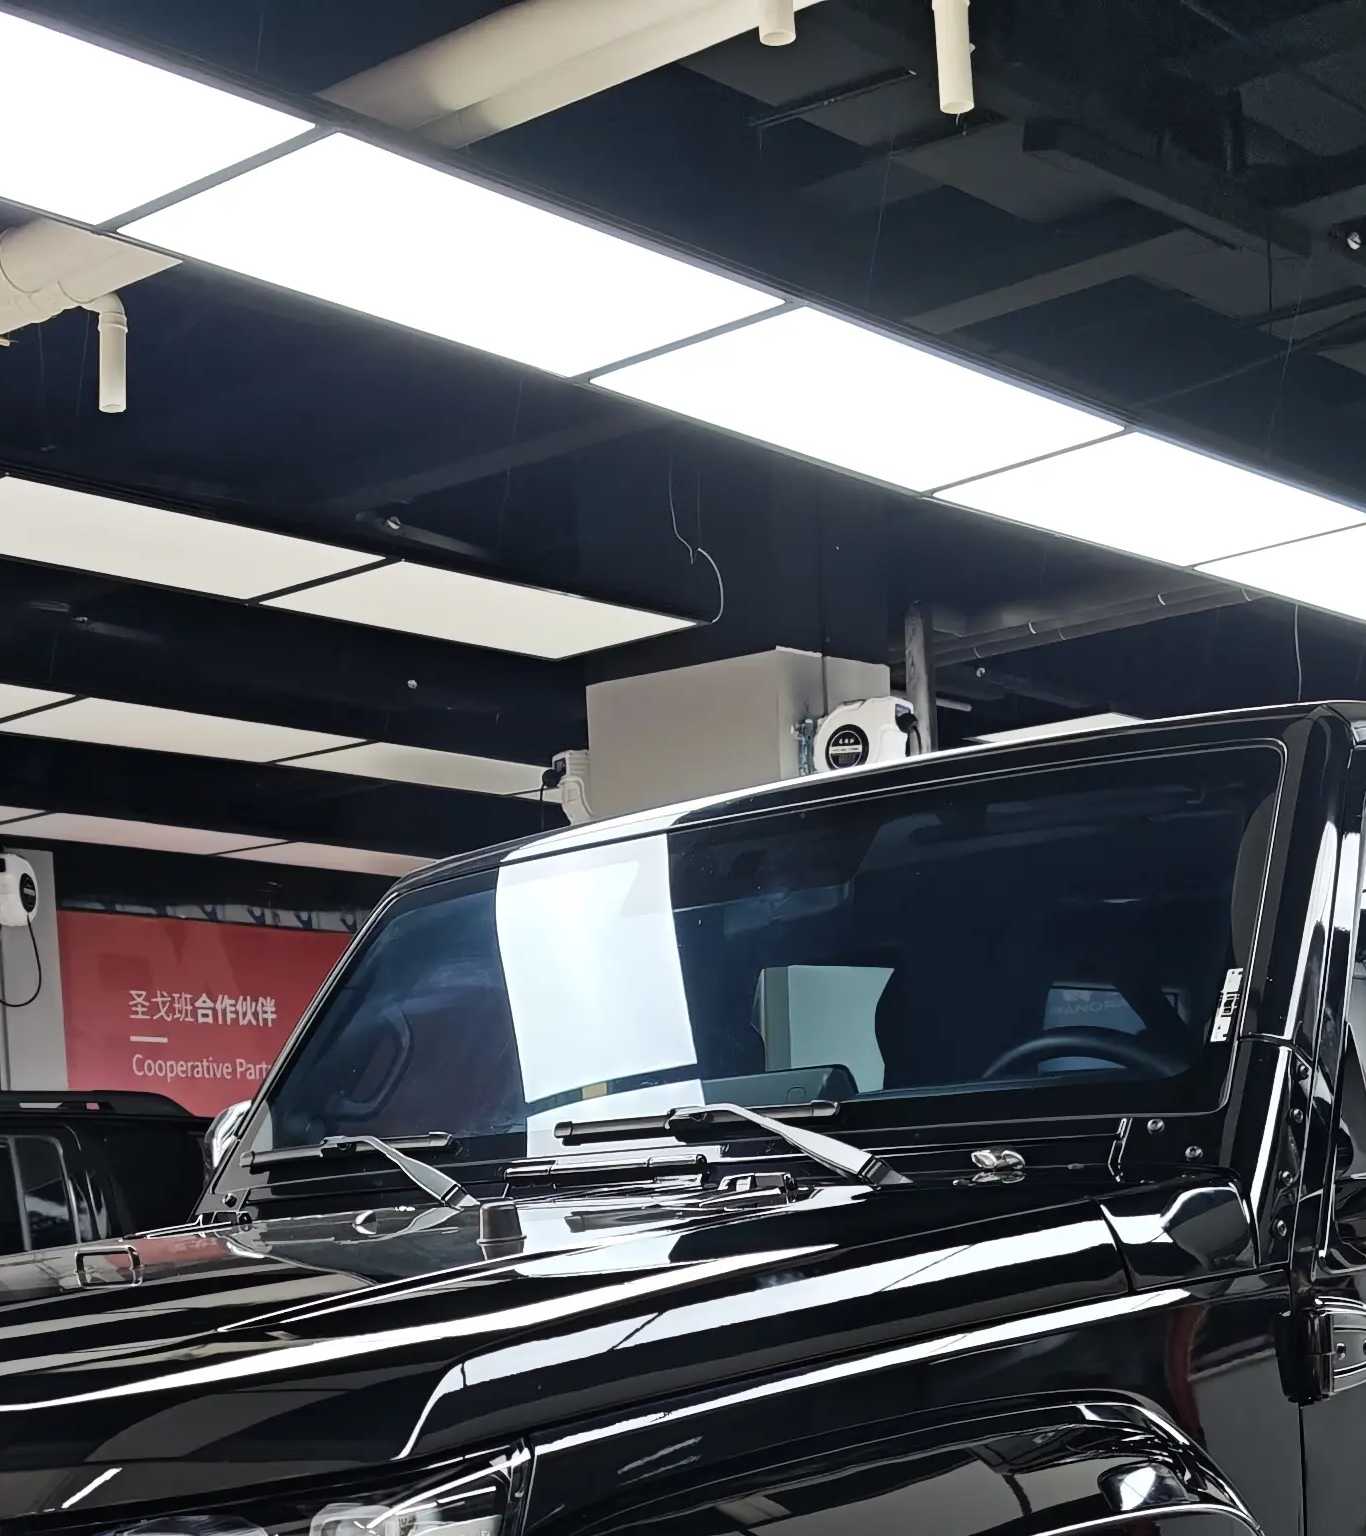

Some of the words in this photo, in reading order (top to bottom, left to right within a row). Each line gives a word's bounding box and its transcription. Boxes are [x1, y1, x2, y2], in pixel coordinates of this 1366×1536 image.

[128, 989, 278, 1028] 圣戈班合作伙伴
[132, 1054, 233, 1082] Cooperative
